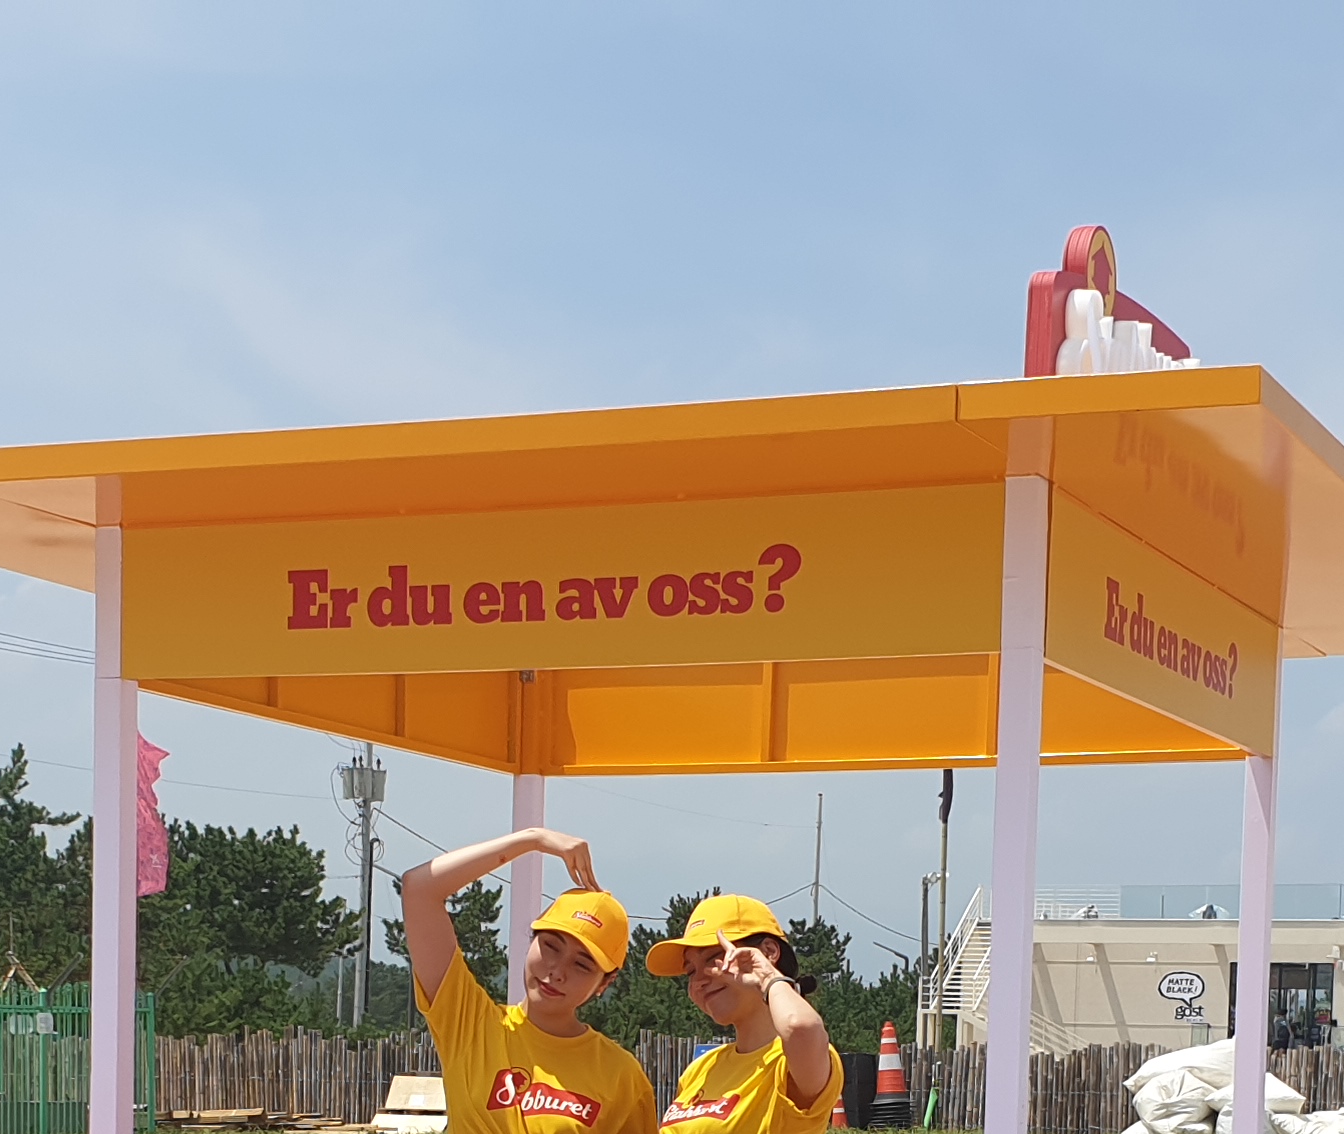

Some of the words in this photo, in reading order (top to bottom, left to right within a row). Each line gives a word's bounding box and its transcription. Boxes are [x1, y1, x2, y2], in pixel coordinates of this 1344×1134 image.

[287, 568, 359, 631] Er
[366, 564, 453, 628] du
[462, 579, 546, 625] en
[555, 575, 640, 621] av
[646, 542, 803, 617] oss?
[1104, 576, 1128, 647] Er
[1129, 592, 1155, 661] du
[1157, 625, 1178, 673] en
[1180, 637, 1202, 682] av
[1203, 642, 1238, 699] oss?
[1167, 978, 1196, 986] MATTE
